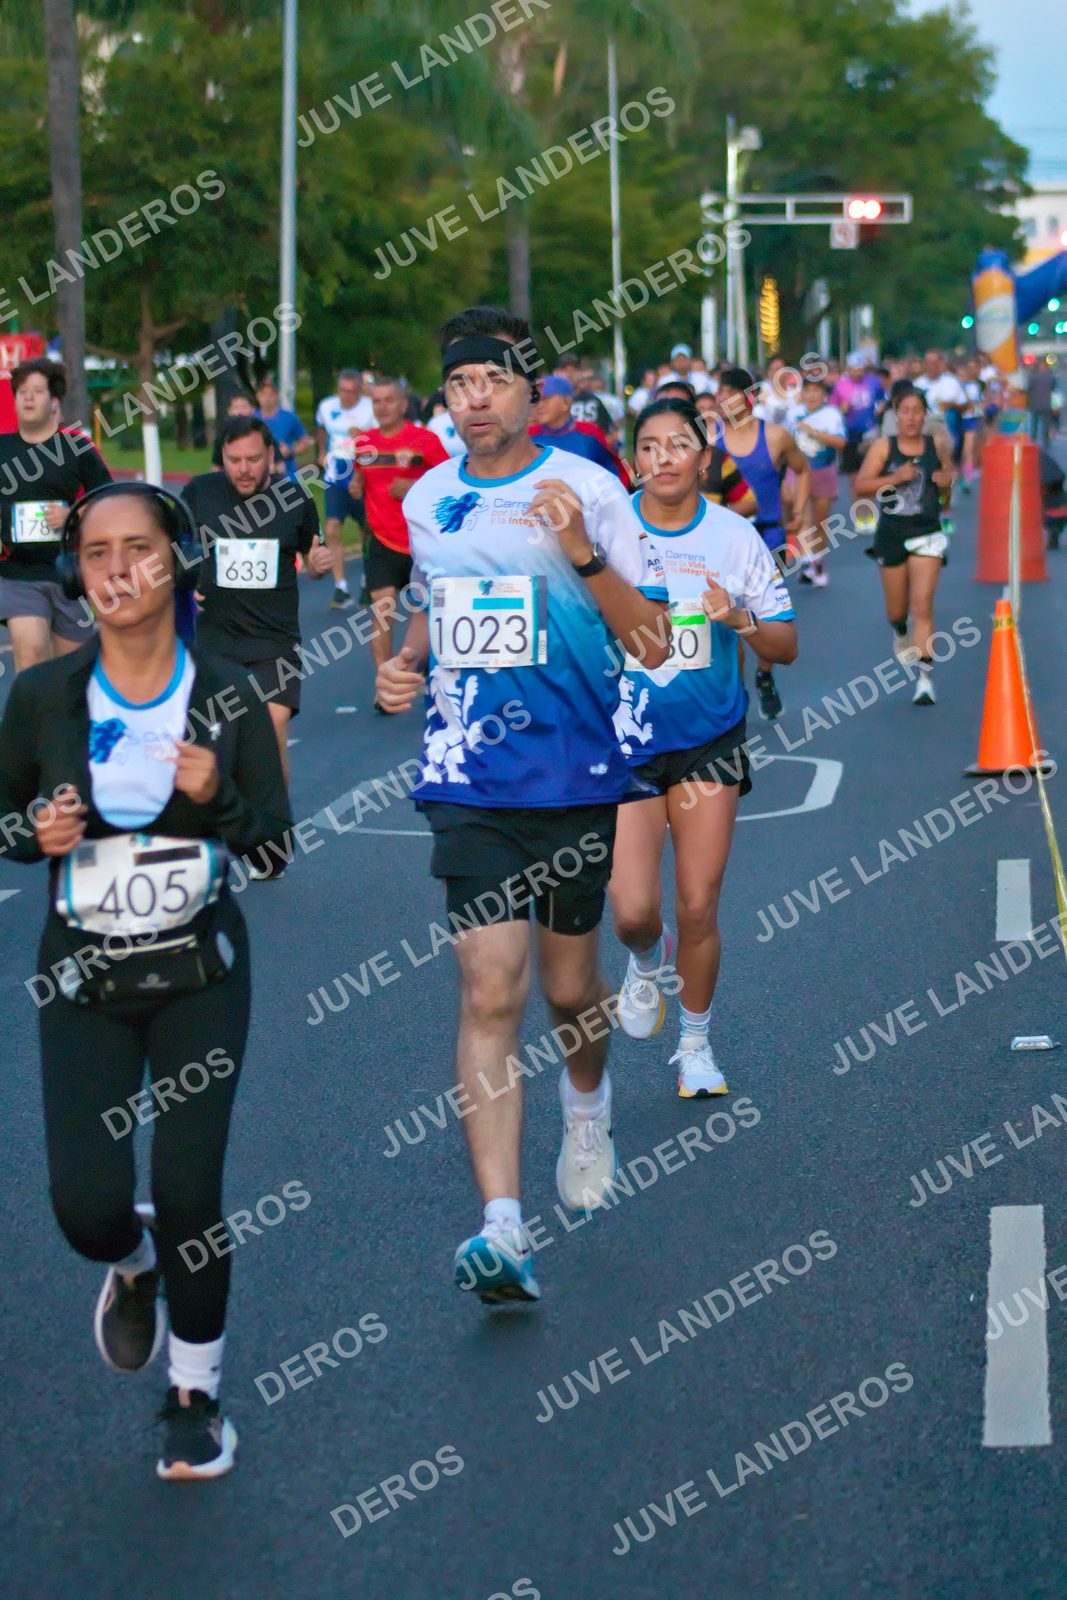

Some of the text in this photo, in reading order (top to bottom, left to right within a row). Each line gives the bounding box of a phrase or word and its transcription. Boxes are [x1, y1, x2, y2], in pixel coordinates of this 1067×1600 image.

[226, 561, 267, 581] 633
[435, 615, 528, 656] 1023
[97, 869, 189, 919] 405
